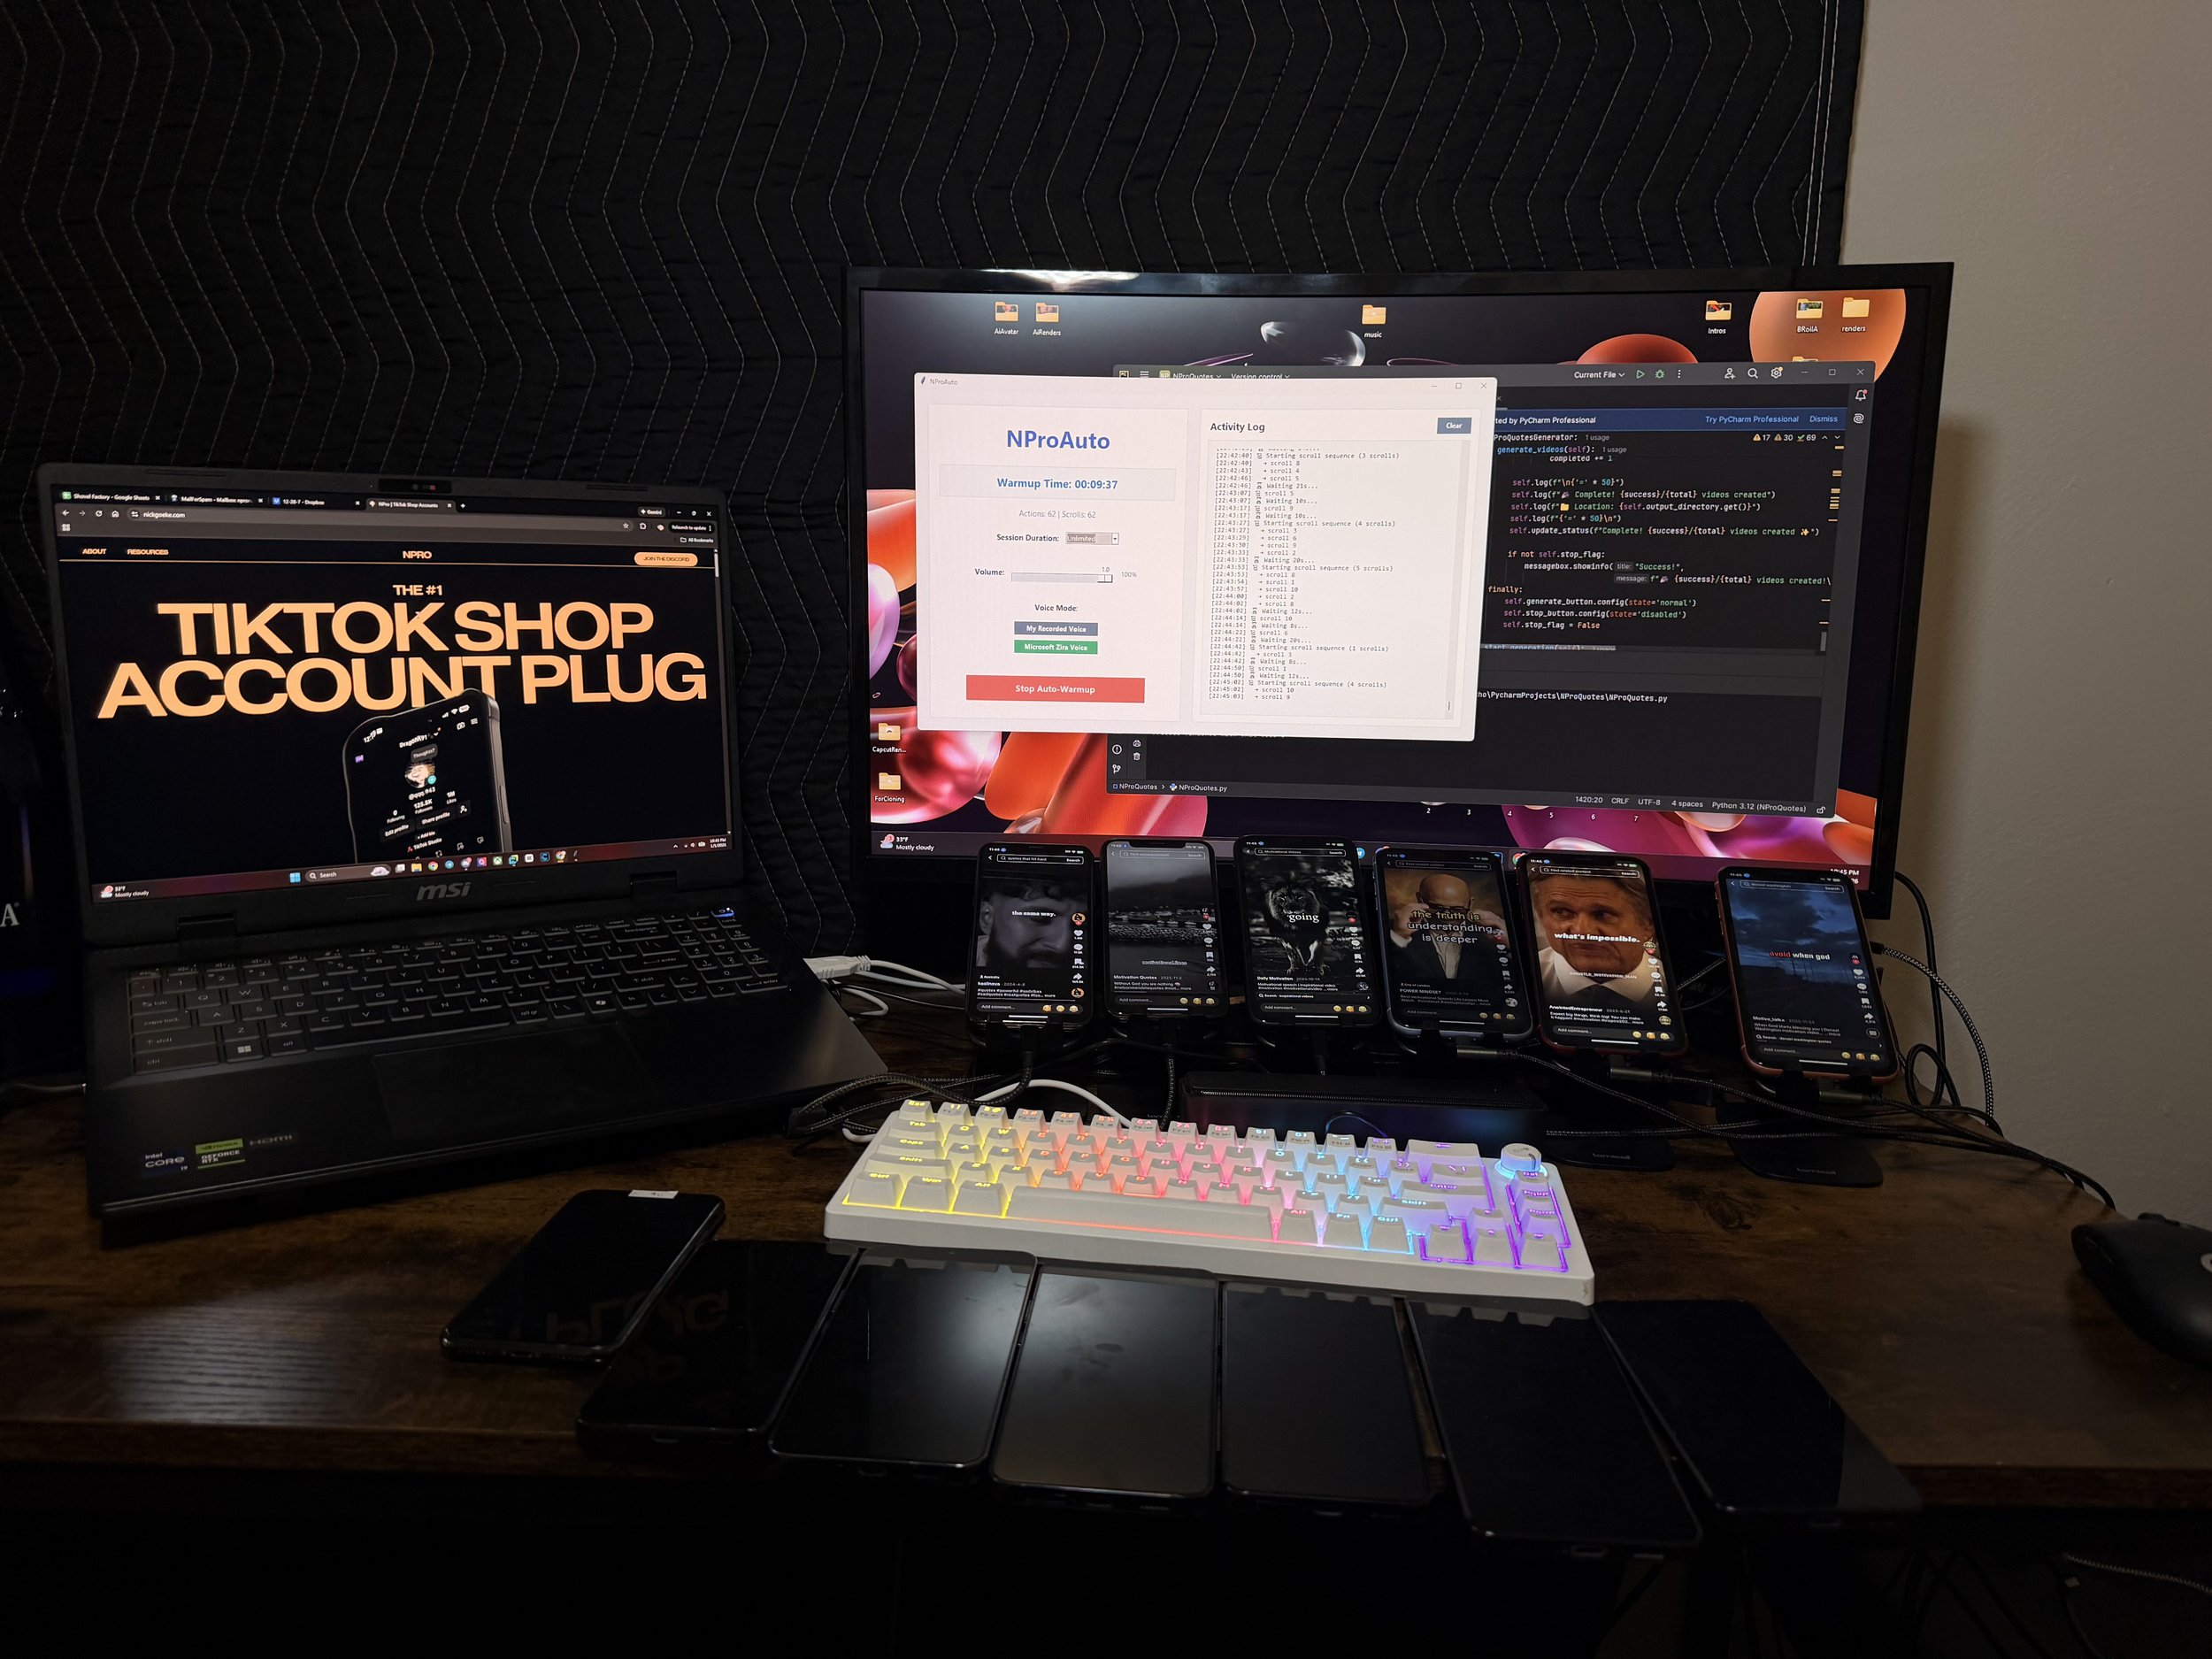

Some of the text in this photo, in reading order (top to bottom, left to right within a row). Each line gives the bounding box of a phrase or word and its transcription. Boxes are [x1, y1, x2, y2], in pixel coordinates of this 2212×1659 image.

[1033, 327, 1061, 336] AiRenders
[1210, 423, 1265, 433] Activity Log
[1007, 430, 1110, 449] NProAuto
[997, 479, 1118, 489] Warmup Time: 00:09:37
[393, 585, 443, 596] THE #1
[157, 602, 654, 656] TIKTOK SHOP
[98, 653, 707, 719] ACCOUNT PLUG
[1016, 685, 1095, 695] Stop Auto-Warmup
[1478, 691, 1668, 703] ho\PycharmProjects\NProQuotes\NProQuotes.py
[1712, 802, 1737, 810] Python
[1757, 804, 1806, 813] (NProQuotes)
[435, 811, 450, 821] profile
[395, 824, 409, 834] profile
[417, 882, 472, 901] msi
[1288, 913, 1319, 923] going
[1408, 923, 1493, 933] understanding
[1436, 934, 1478, 943] deeper
[1586, 933, 1640, 942] impossible.
